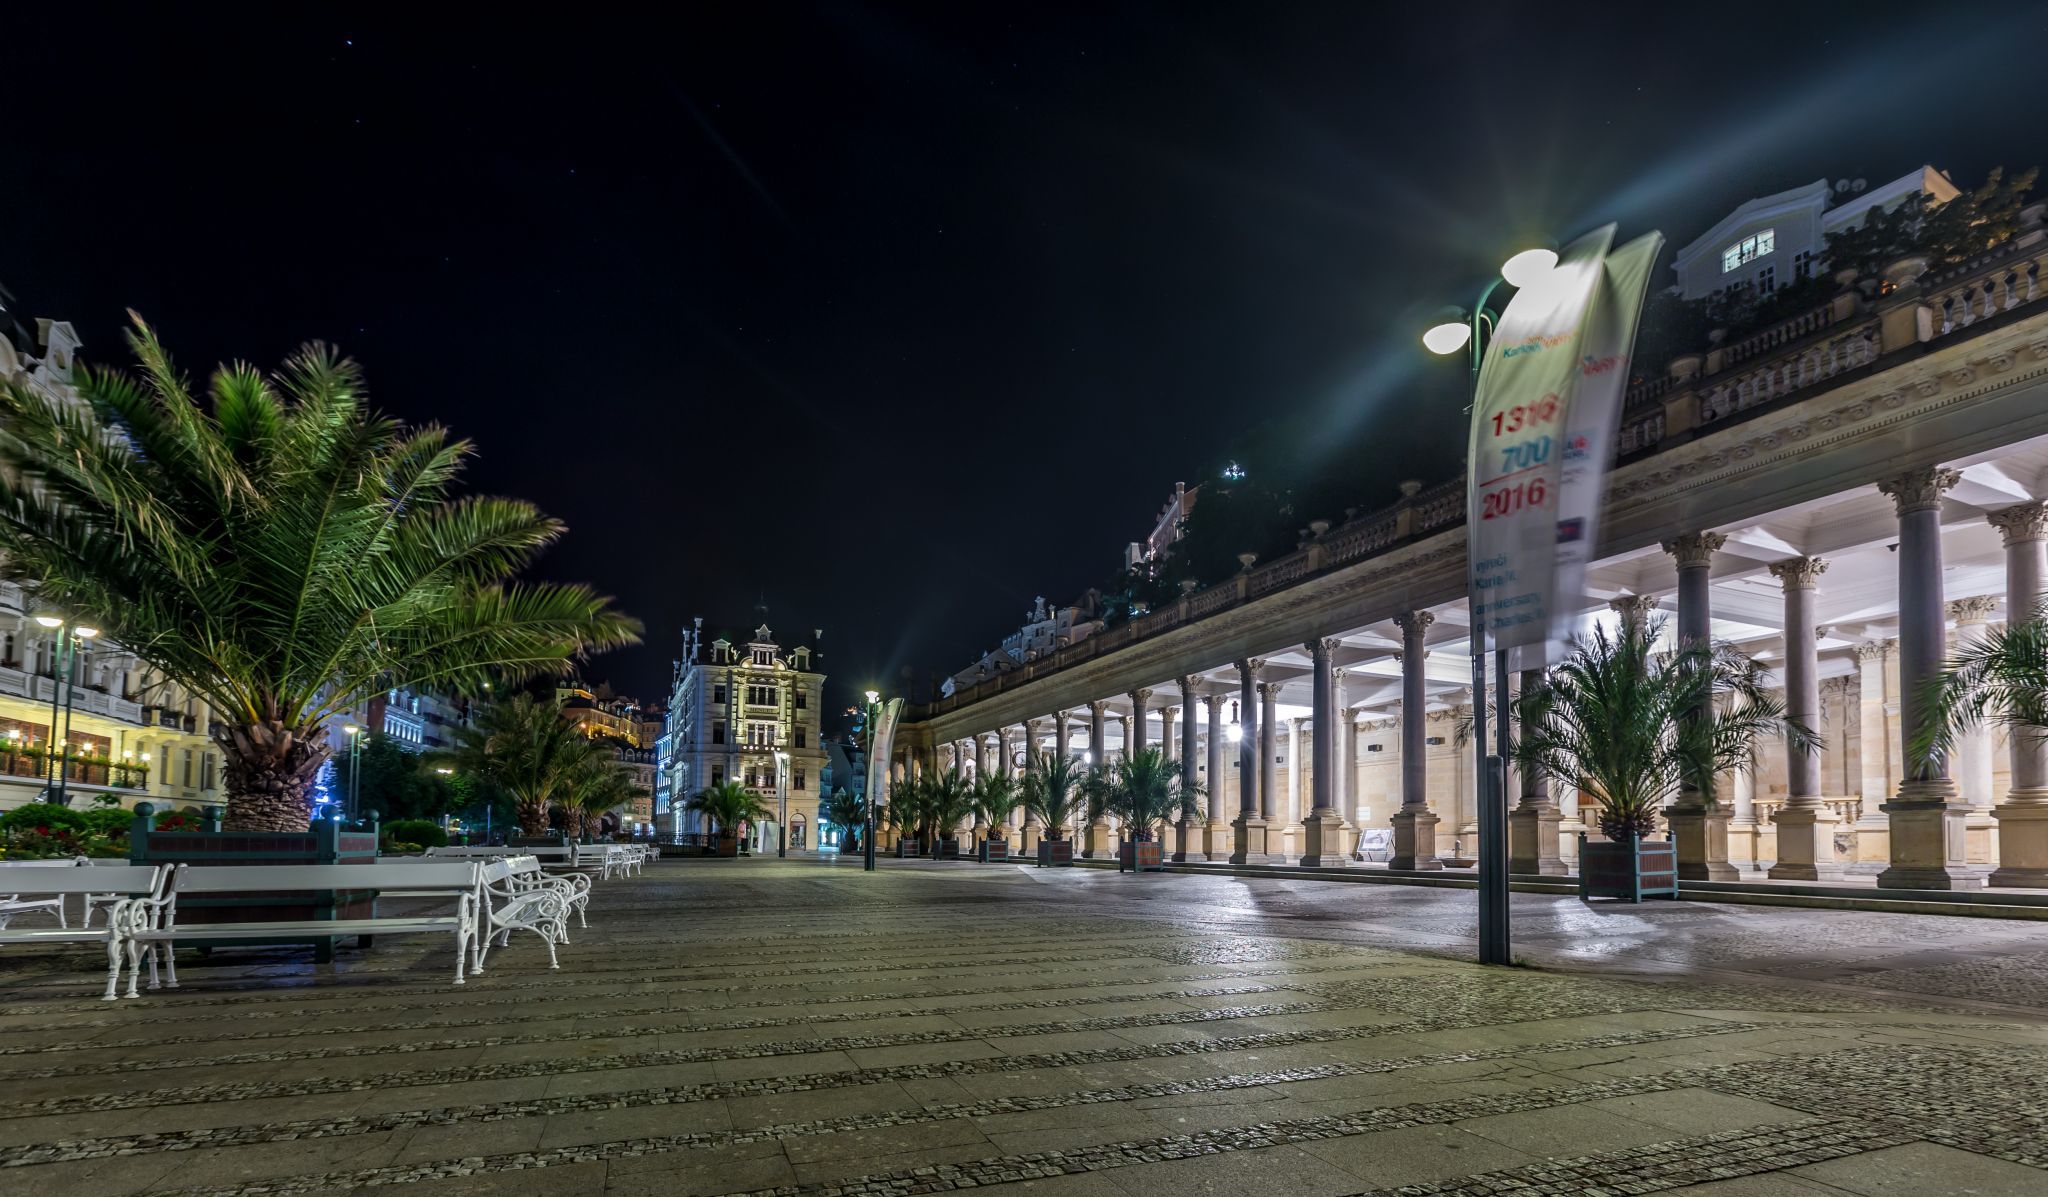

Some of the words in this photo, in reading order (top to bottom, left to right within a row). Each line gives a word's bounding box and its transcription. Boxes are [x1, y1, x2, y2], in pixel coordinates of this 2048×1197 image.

[1492, 393, 1557, 437] 1316
[1502, 435, 1550, 473] 700
[1481, 478, 1546, 521] 2016
